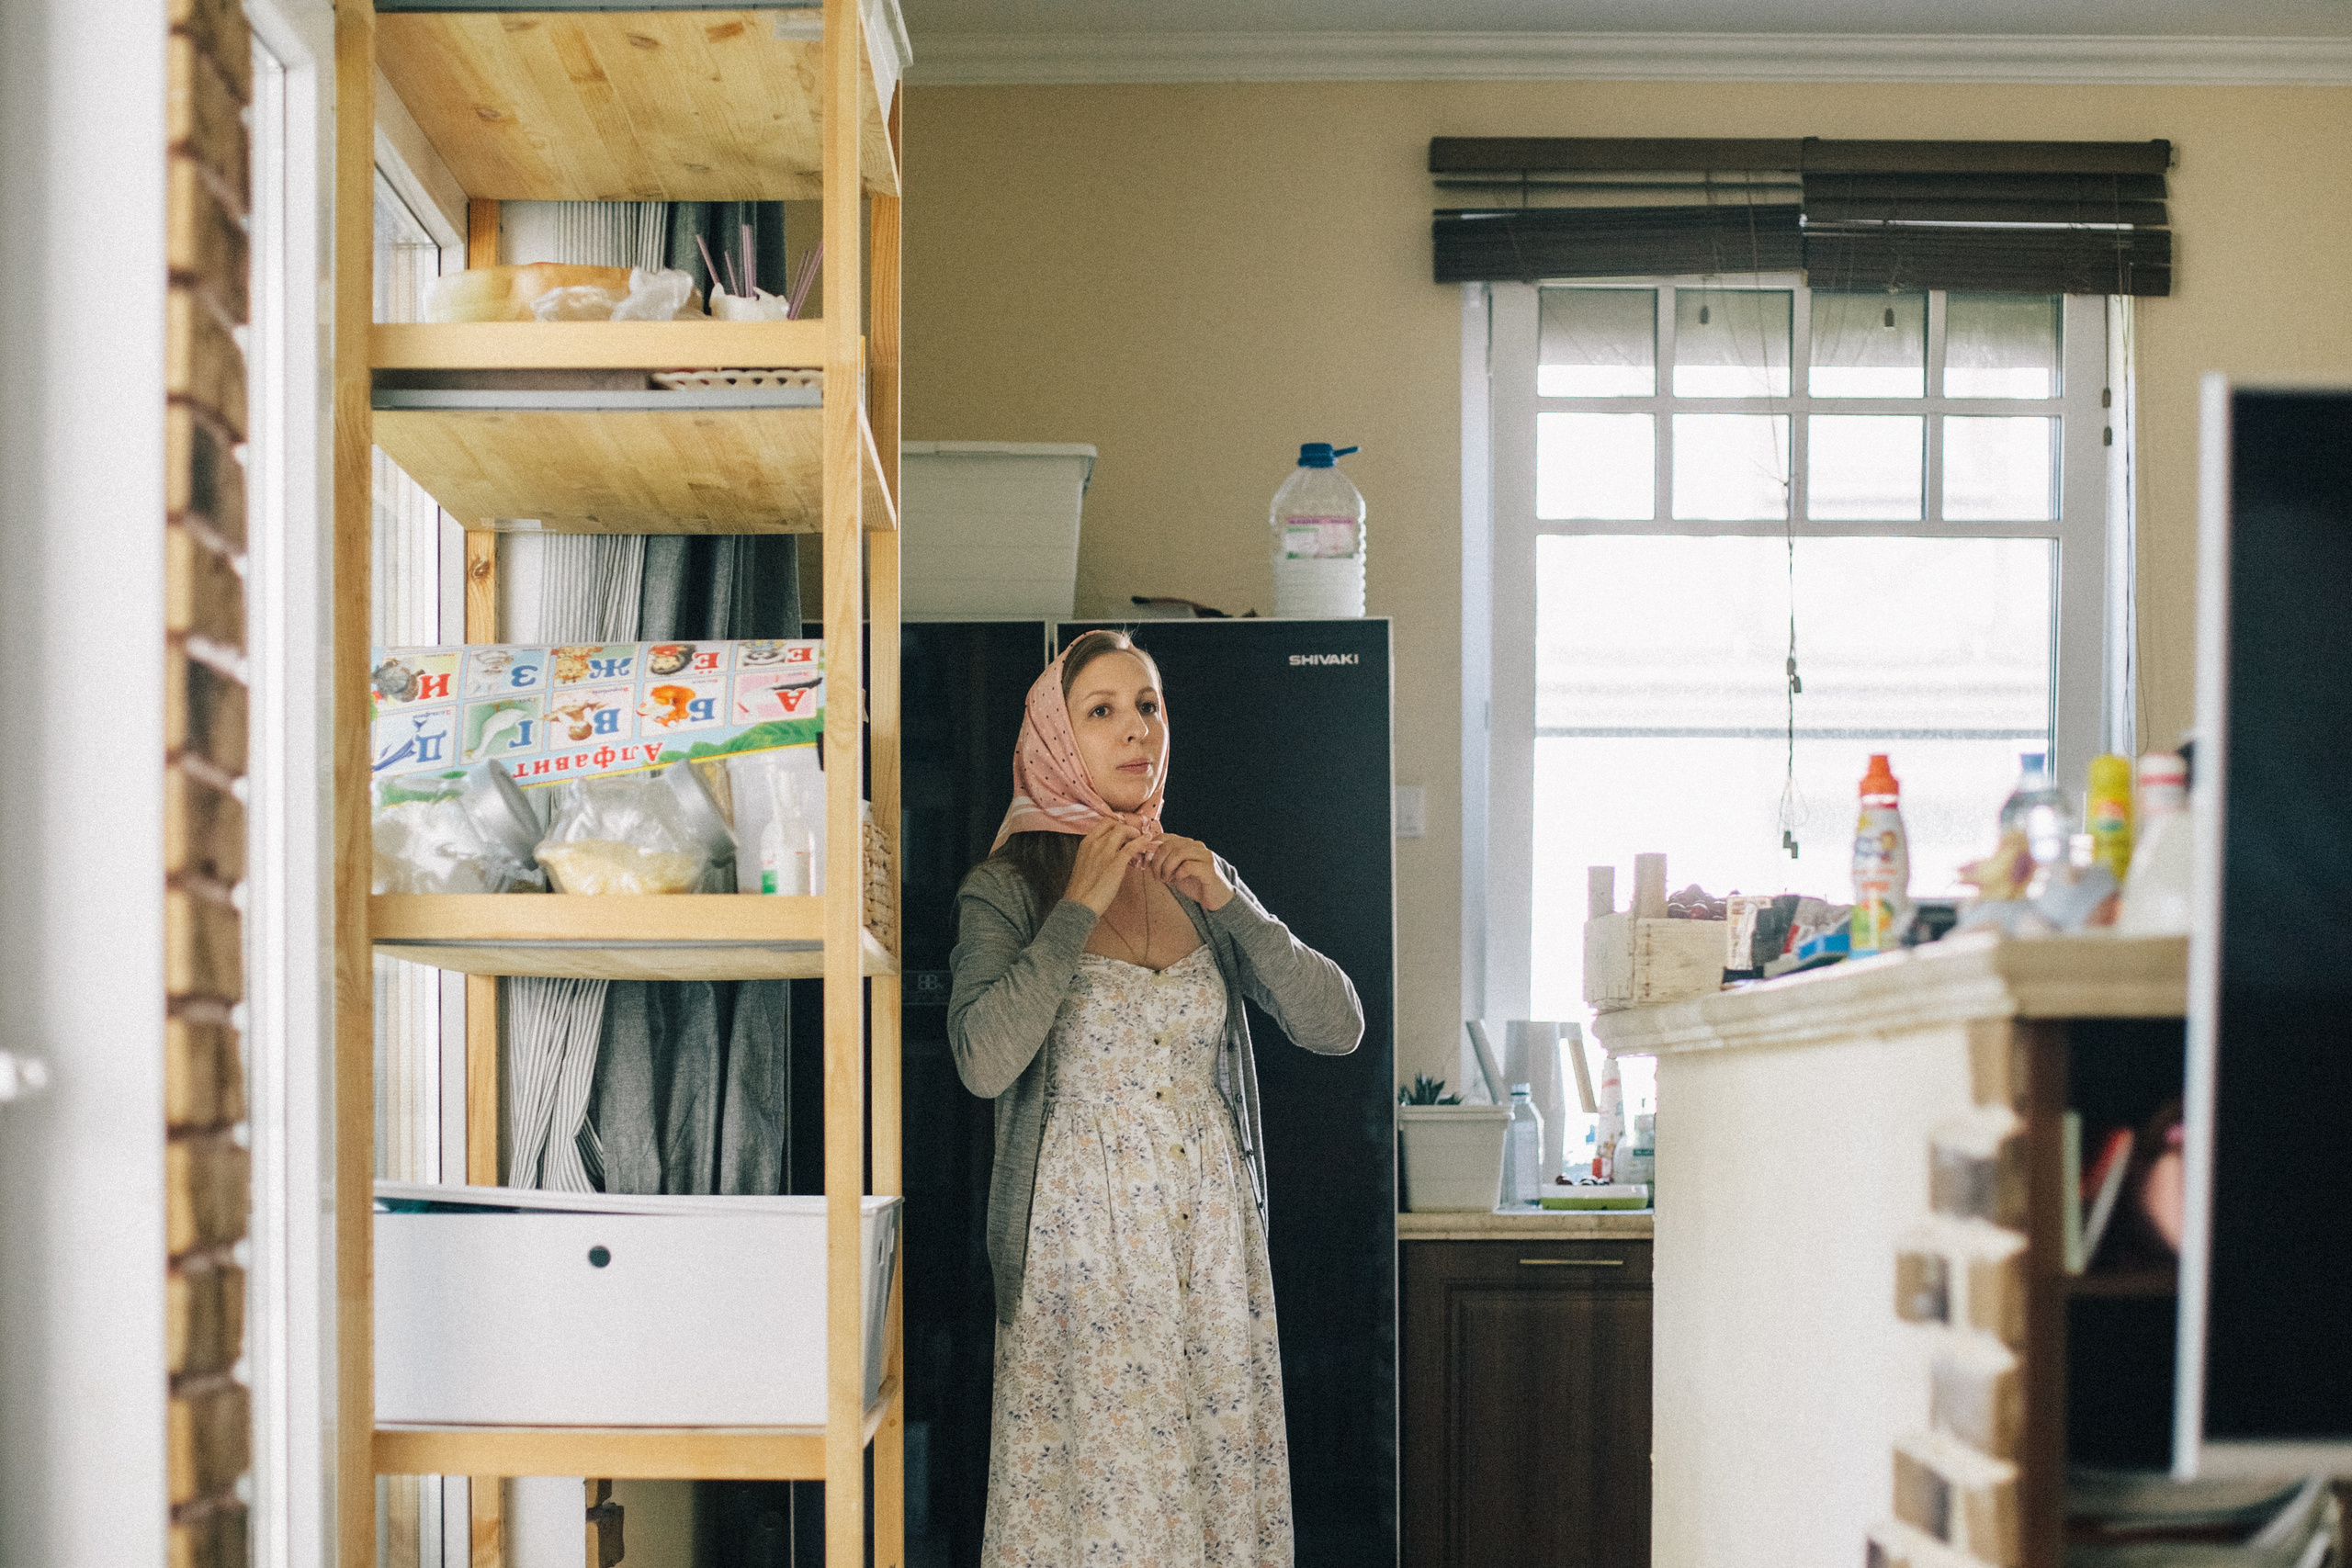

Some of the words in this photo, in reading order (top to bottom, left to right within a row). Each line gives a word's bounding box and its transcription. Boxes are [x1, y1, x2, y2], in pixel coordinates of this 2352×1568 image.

[694, 652, 718, 674] Ё
[788, 647, 813, 663] Е
[1288, 653, 1359, 666] SHIVAKI
[511, 665, 538, 687] З
[589, 657, 633, 679] Ж
[418, 672, 451, 700] И
[689, 697, 717, 722] Б
[775, 689, 808, 713] А
[594, 708, 621, 735] В
[415, 729, 447, 763] Д
[509, 719, 534, 749] Г
[513, 741, 663, 778] Алфавит
